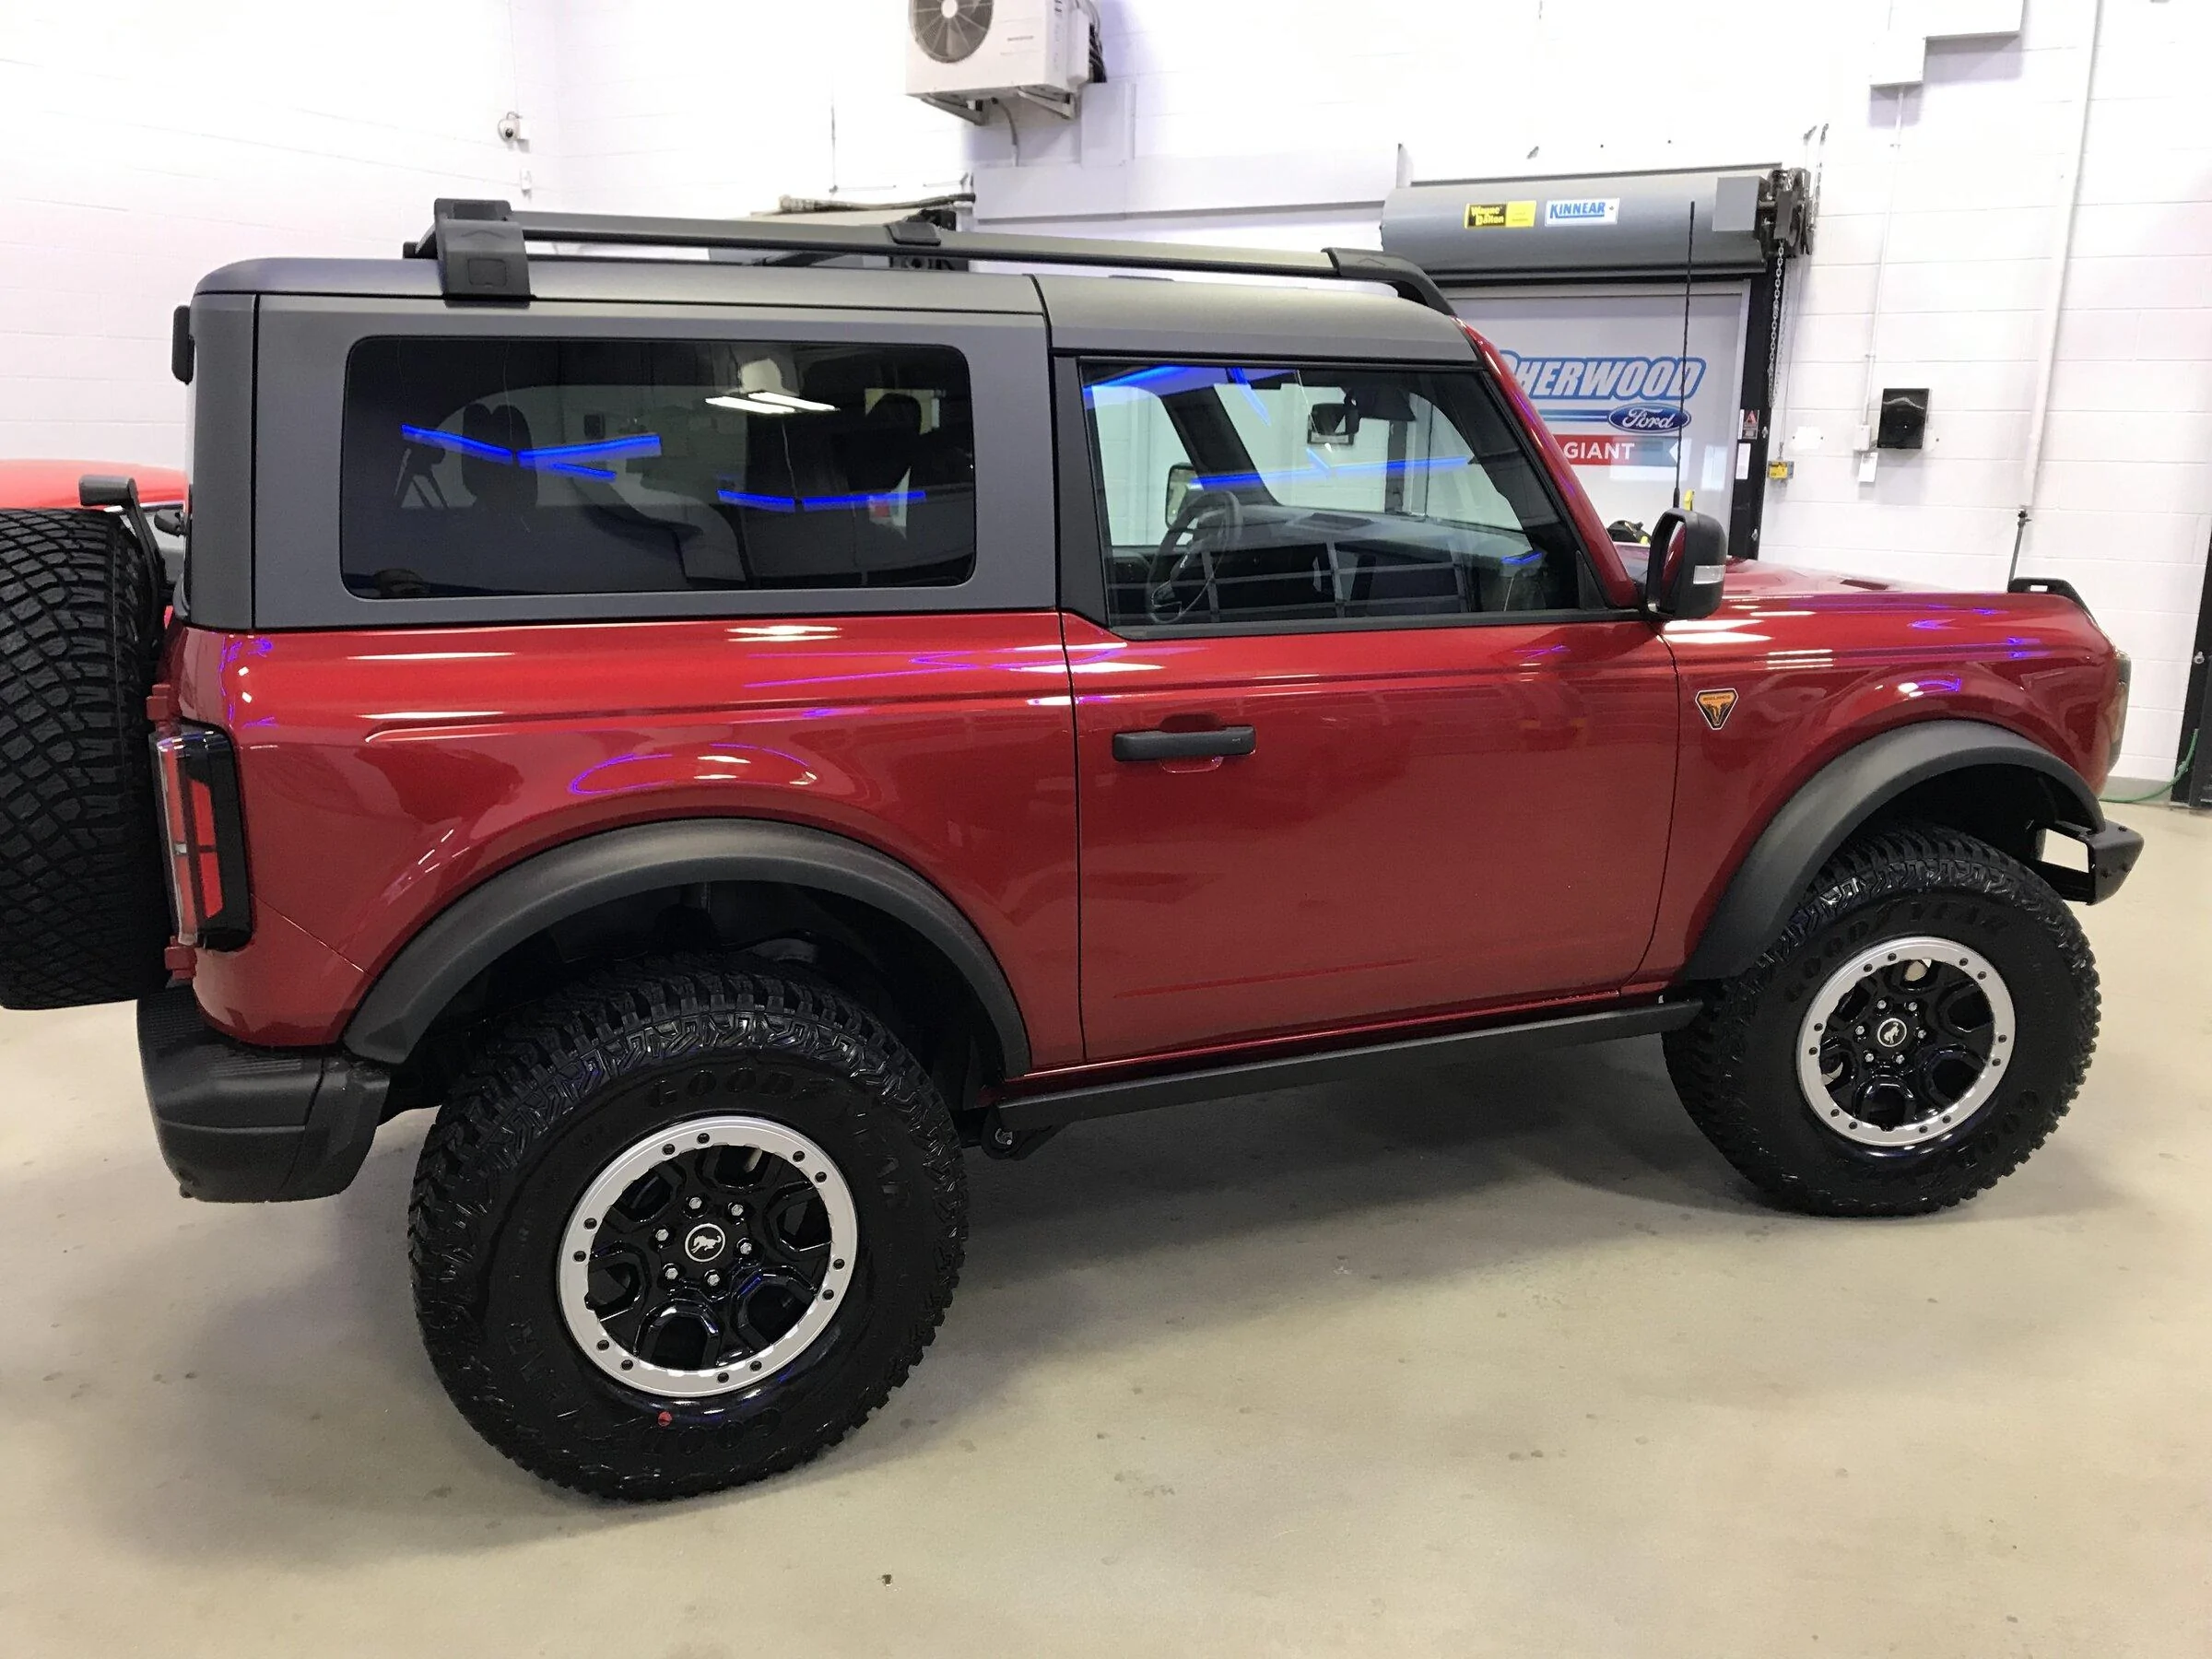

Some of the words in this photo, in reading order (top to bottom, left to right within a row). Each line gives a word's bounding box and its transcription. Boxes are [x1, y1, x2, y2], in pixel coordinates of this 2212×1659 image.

[1549, 202, 1606, 218] KINNEAR
[1621, 407, 1676, 429] Ford
[1564, 441, 1635, 461] GIANT
